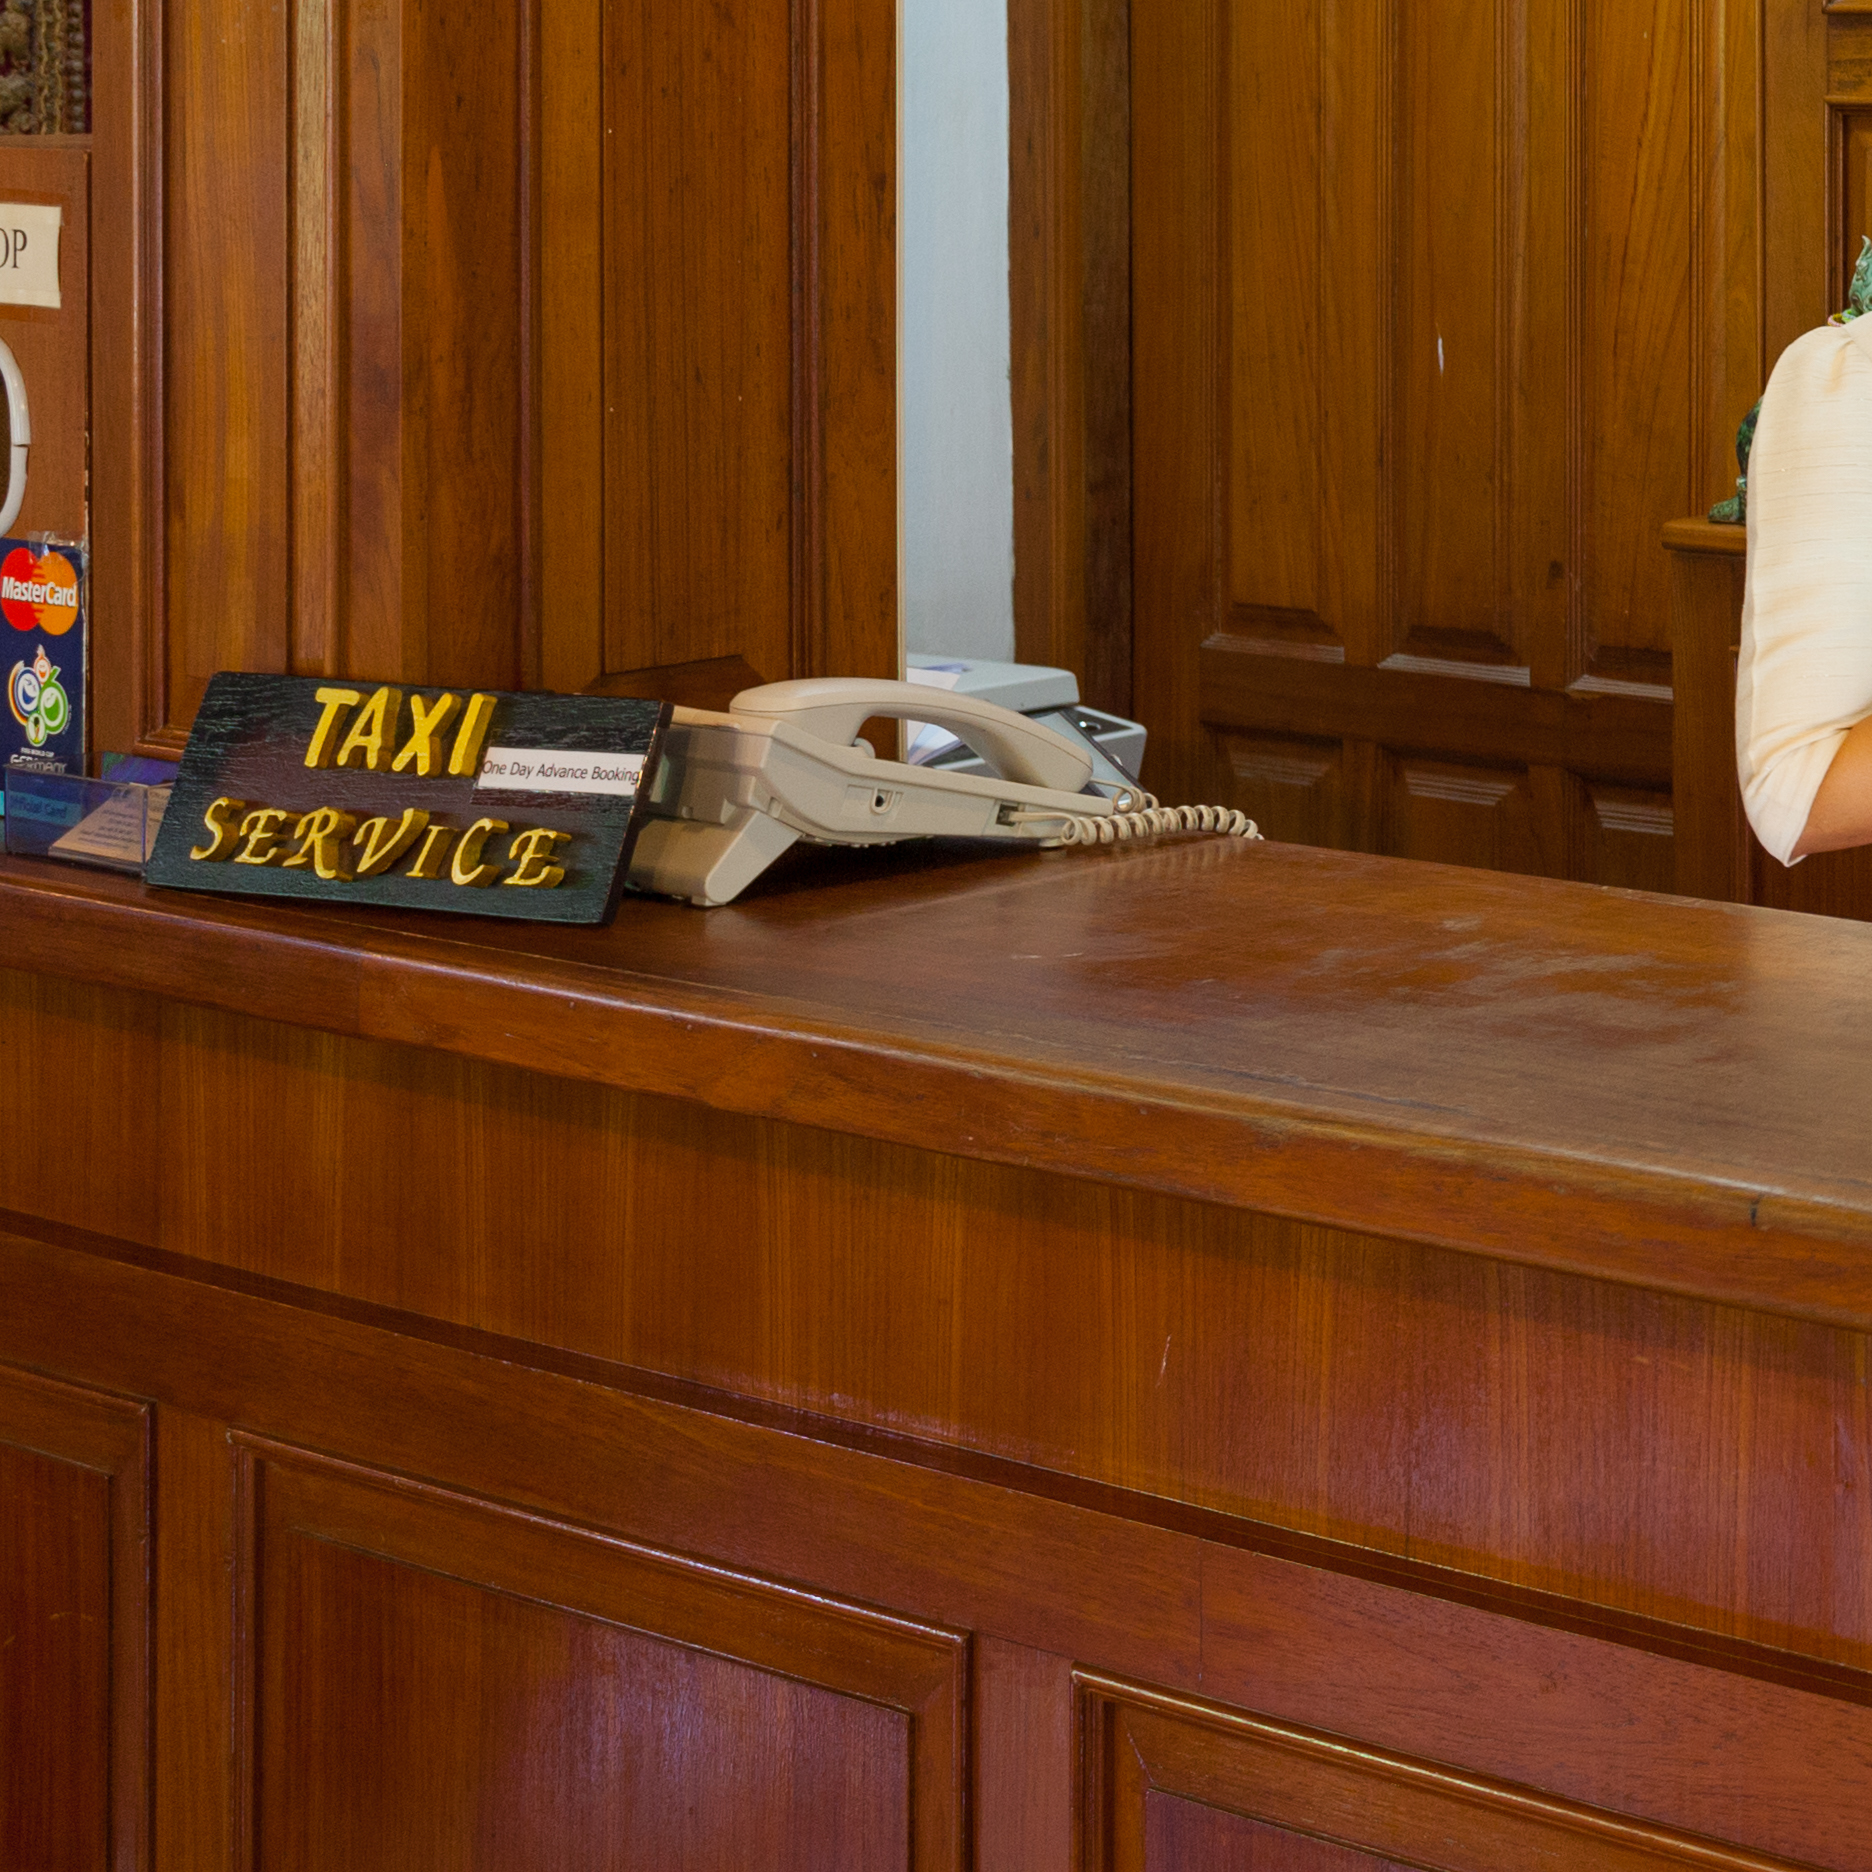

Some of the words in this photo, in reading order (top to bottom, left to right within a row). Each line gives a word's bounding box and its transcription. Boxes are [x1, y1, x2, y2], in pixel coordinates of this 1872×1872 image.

[1, 576, 79, 607] MasterCard
[304, 686, 499, 778] TAXI
[482, 760, 507, 775] One
[511, 761, 534, 778] Day
[536, 763, 588, 780] Advance
[591, 766, 641, 785] Booking
[190, 796, 572, 890] SERVICE
